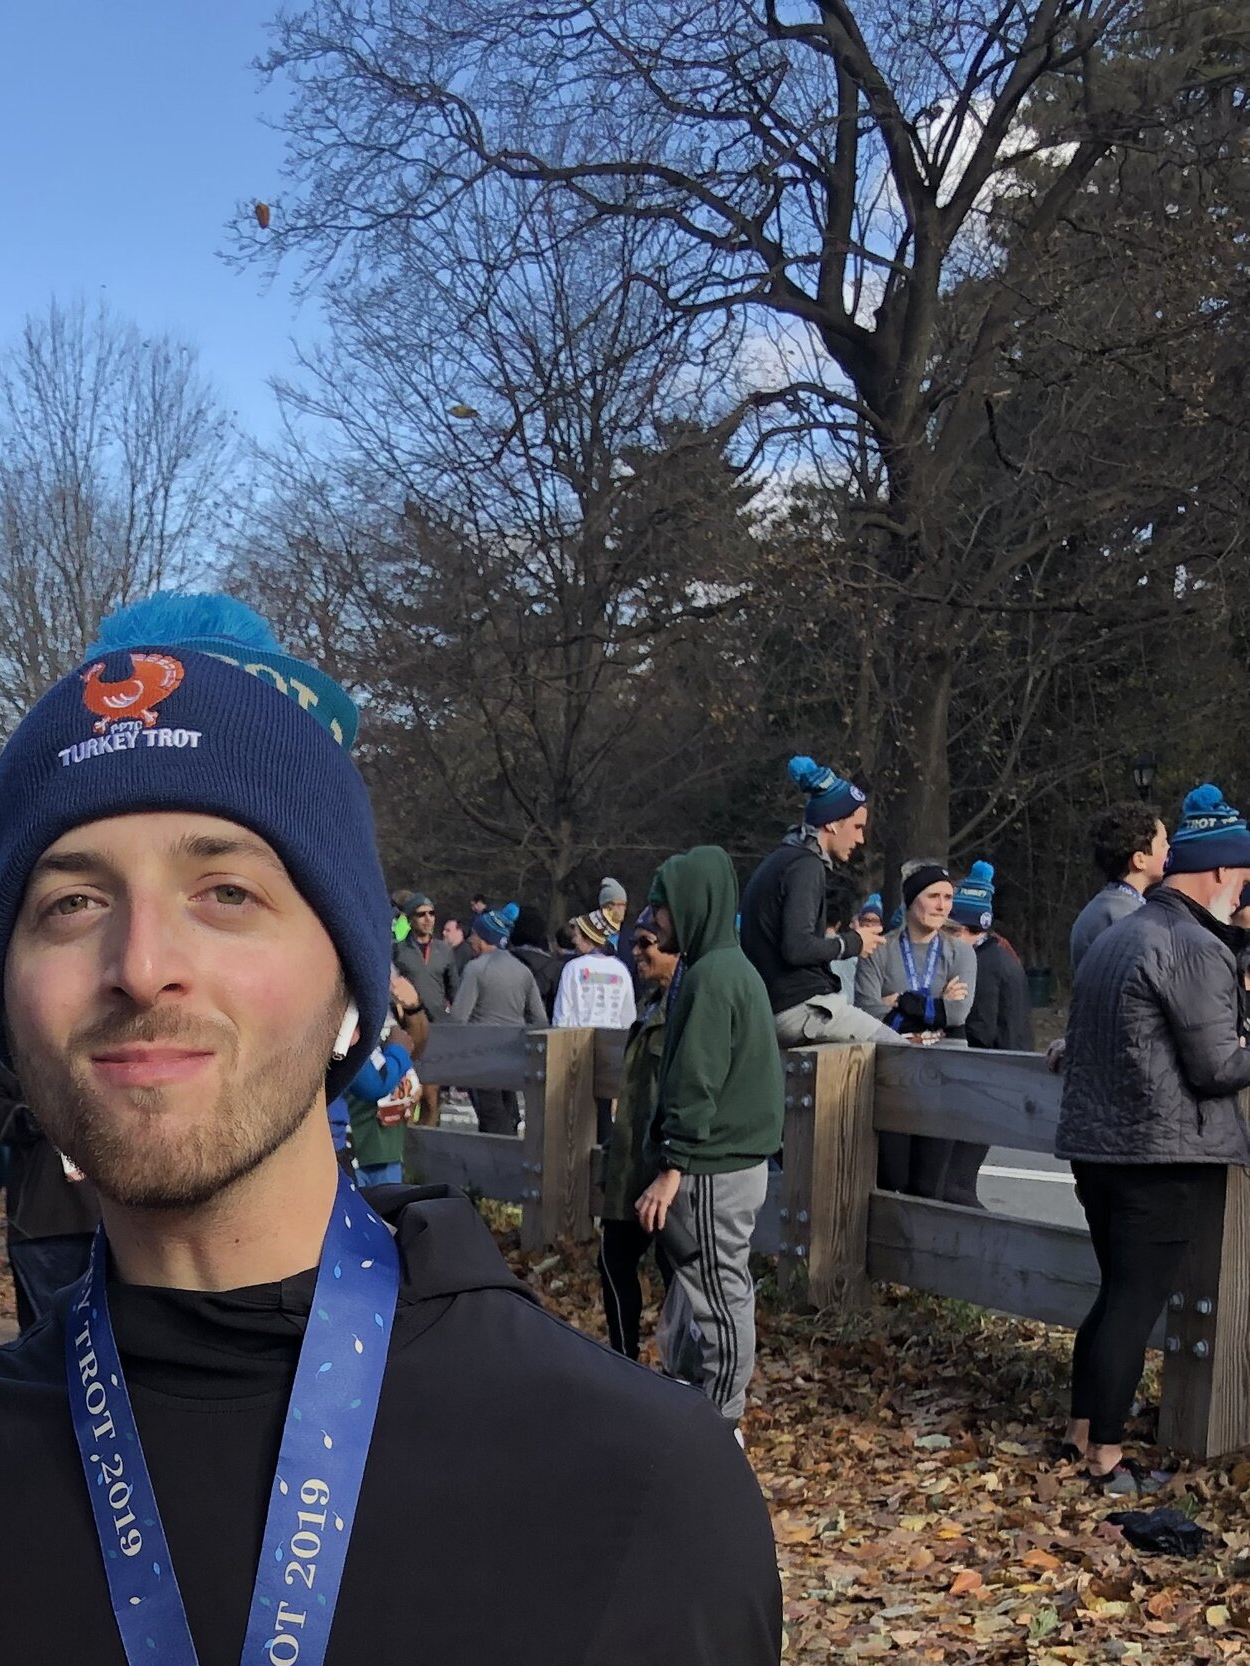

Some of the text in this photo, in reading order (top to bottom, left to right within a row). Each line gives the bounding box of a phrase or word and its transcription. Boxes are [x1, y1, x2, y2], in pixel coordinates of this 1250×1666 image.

[58, 728, 202, 766] TURKEY TROT
[74, 1320, 116, 1441] TROT
[100, 1453, 143, 1557] 2019
[285, 1478, 331, 1589] 2019
